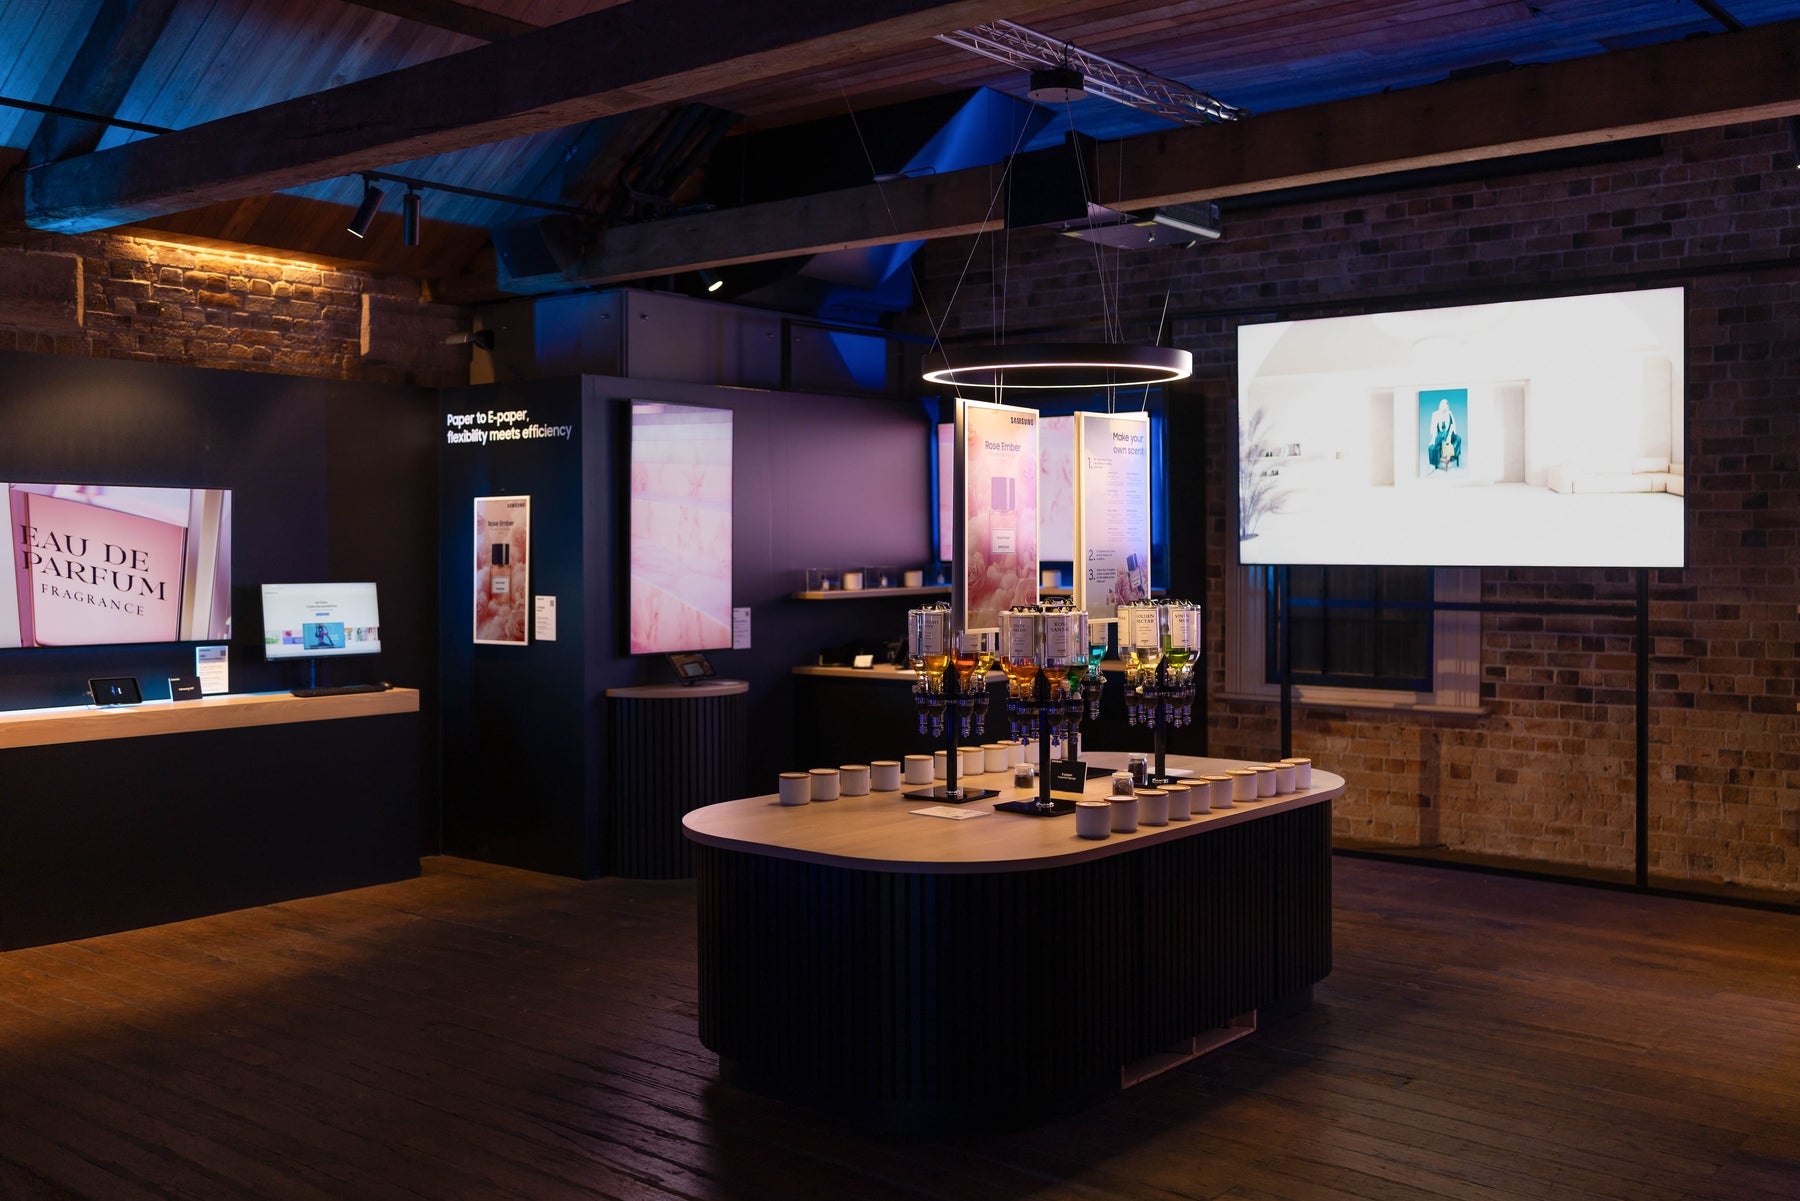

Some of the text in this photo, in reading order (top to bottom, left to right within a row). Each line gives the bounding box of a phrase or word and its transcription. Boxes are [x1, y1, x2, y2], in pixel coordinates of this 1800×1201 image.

[447, 410, 530, 429] Paper to E-paper,
[1010, 416, 1034, 426] SAMSUNG
[447, 424, 572, 445] flexibility meets efficiency
[1112, 432, 1144, 445] Make your
[985, 440, 1021, 452] Rose Ember
[1113, 446, 1145, 456] own scent
[20, 524, 150, 573] EAU DE
[1088, 549, 1096, 561] 2.
[22, 550, 168, 602] PARFUM
[1088, 568, 1096, 581] 3.
[41, 583, 145, 617] FRAGRANCE
